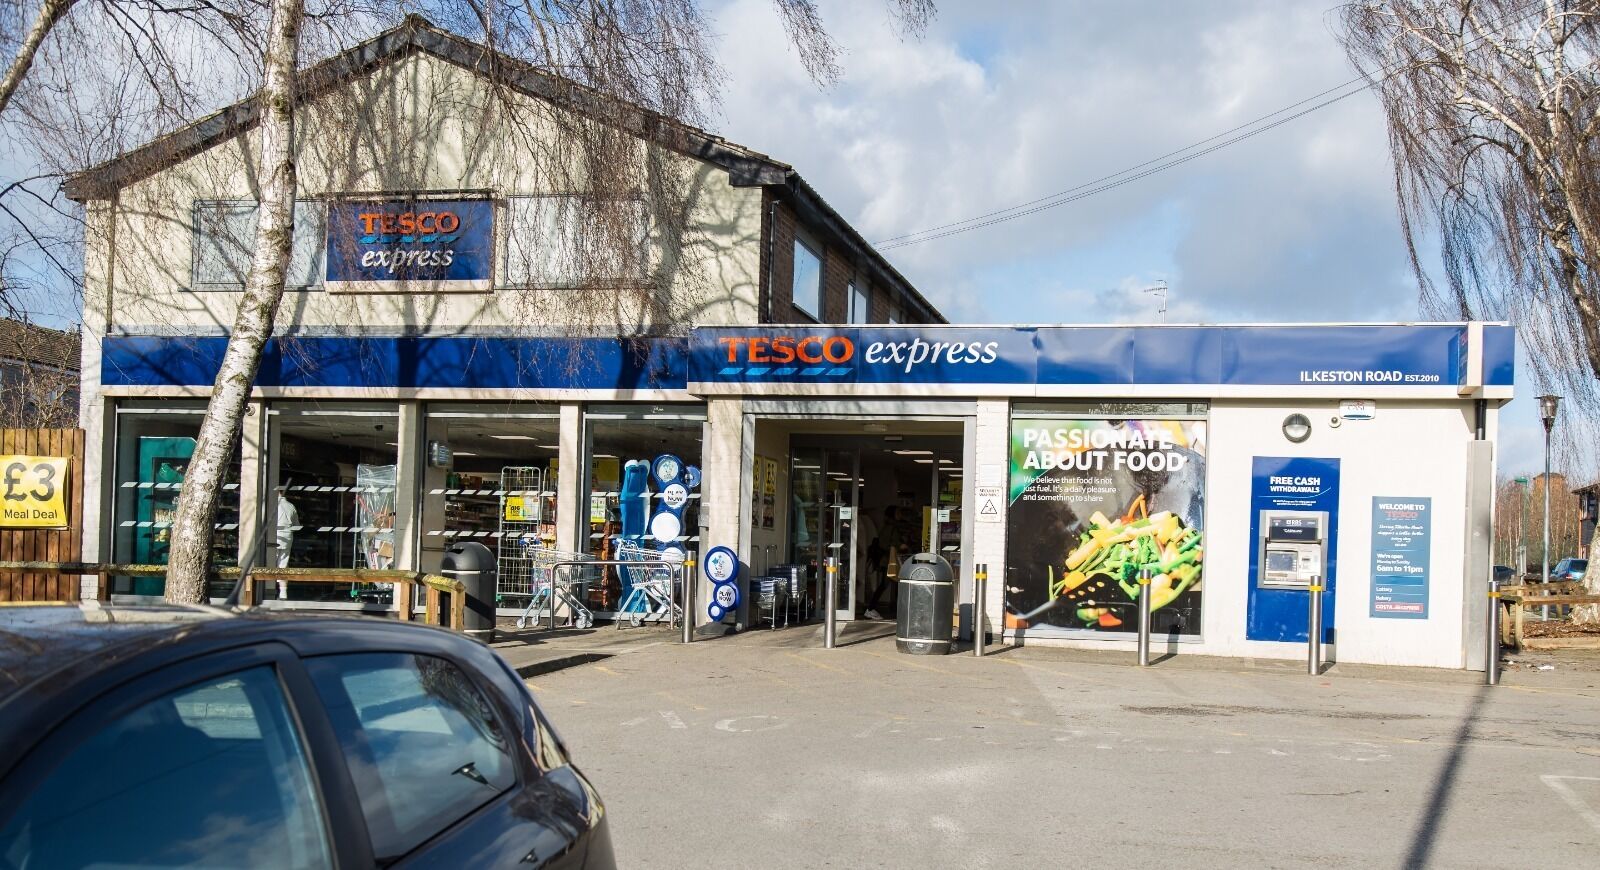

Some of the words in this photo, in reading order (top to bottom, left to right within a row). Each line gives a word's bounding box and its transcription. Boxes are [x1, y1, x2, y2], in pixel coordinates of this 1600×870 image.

[358, 212, 460, 234] TESCO
[362, 248, 454, 274] express
[720, 336, 854, 362] TESCO
[866, 338, 998, 374] express
[1300, 371, 1362, 382] ILKESTON
[1366, 371, 1402, 382] ROAD
[1024, 428, 1172, 450] PASSIONATE
[1023, 450, 1108, 470] ABOUT
[1114, 452, 1184, 472] FOOD
[4, 462, 56, 501] £3
[1270, 476, 1293, 485] FREE
[1294, 477, 1320, 485] CASH
[1023, 485, 1036, 493] just
[1069, 486, 1085, 494] daily
[1087, 486, 1116, 495] pleasure
[1037, 494, 1074, 503] something
[4, 509, 28, 518] Meal
[33, 509, 57, 518] Deal
[1403, 566, 1423, 574] 11pm
